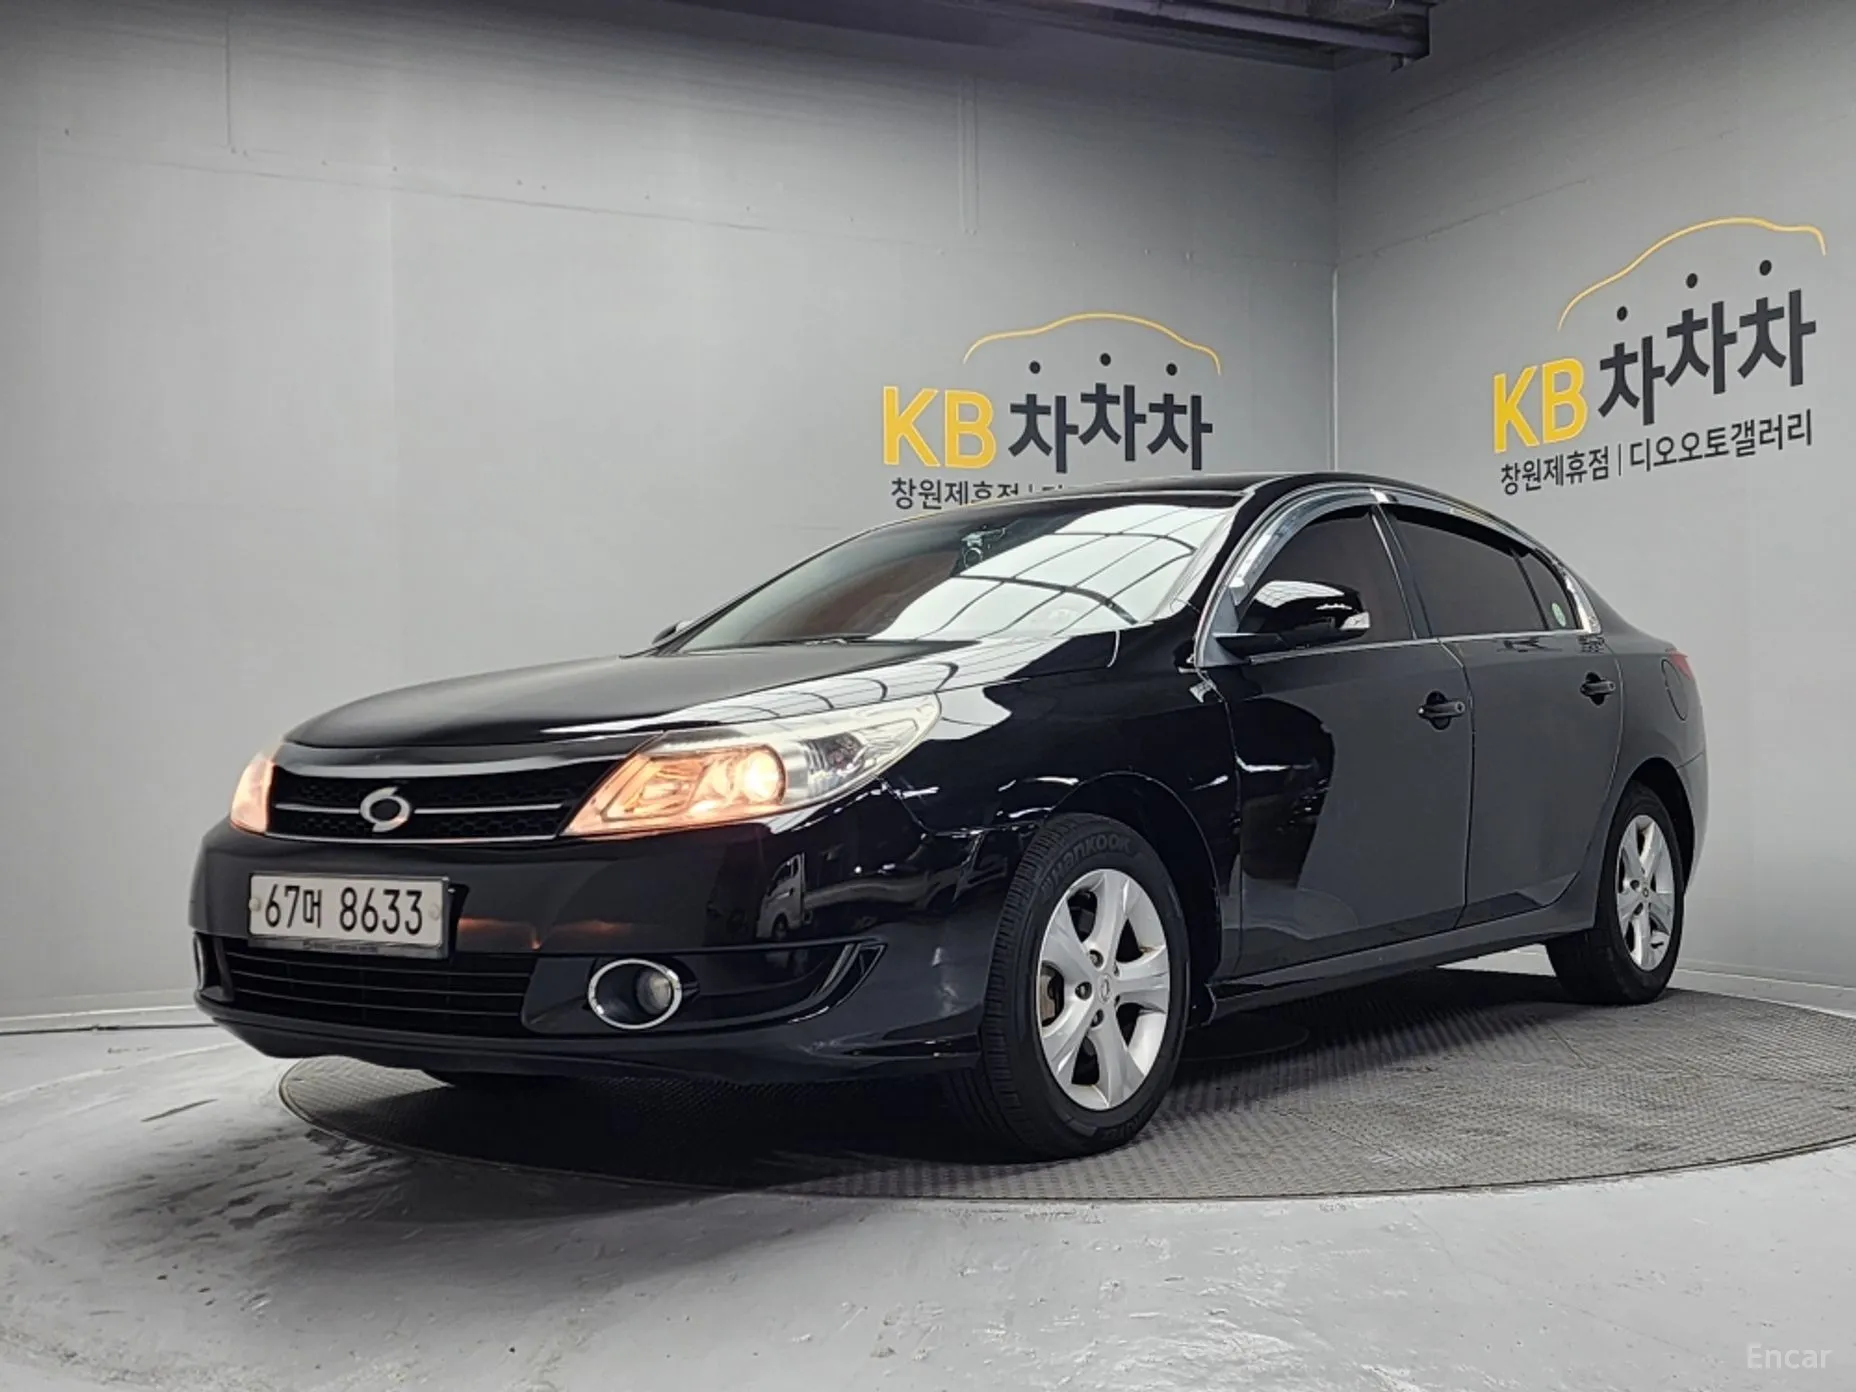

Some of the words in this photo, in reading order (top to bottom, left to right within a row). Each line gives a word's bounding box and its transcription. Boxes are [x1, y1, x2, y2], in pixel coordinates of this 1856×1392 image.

[1500, 445, 1609, 496] 창원제휴점
[1629, 408, 1812, 472] 디오오토갤러리
[265, 883, 323, 929] 67머
[339, 886, 423, 936] 8633
